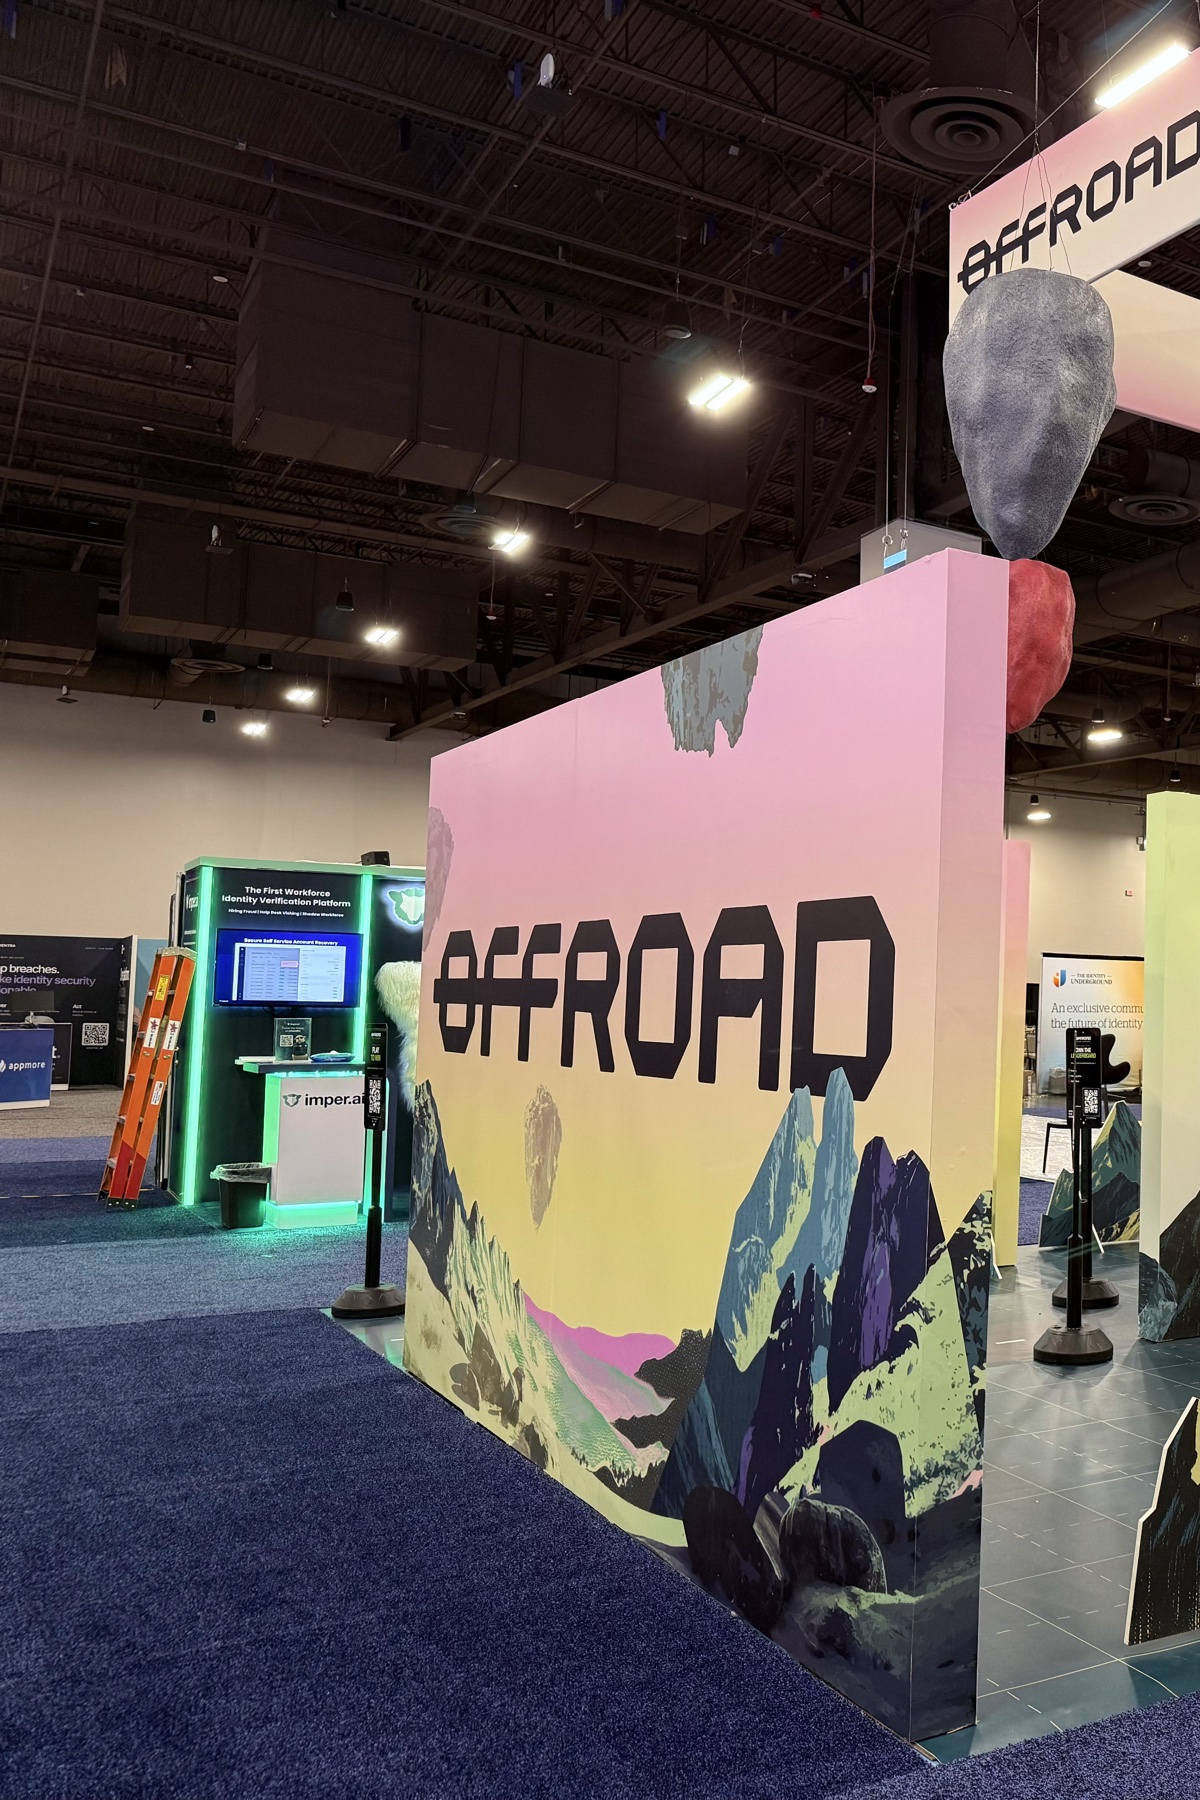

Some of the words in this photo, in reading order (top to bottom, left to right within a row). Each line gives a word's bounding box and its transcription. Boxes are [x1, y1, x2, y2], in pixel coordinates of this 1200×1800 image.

[263, 887, 284, 895] First
[284, 888, 331, 897] Workforce
[221, 895, 258, 905] Identity
[260, 896, 312, 906] Verification
[312, 899, 351, 908] Platform
[9, 964, 60, 975] breaches.
[13, 975, 52, 986] identity
[54, 976, 97, 987] security
[433, 895, 896, 1102] OFFROAD
[1051, 1003, 1065, 1013] An
[1066, 1003, 1110, 1013] exclusive
[1051, 1018, 1067, 1028] the
[1068, 1018, 1097, 1028] future
[1097, 1018, 1107, 1028] of
[1107, 1018, 1143, 1030] identity
[8, 1061, 46, 1072] appmore
[304, 1093, 365, 1108] imper.ai
